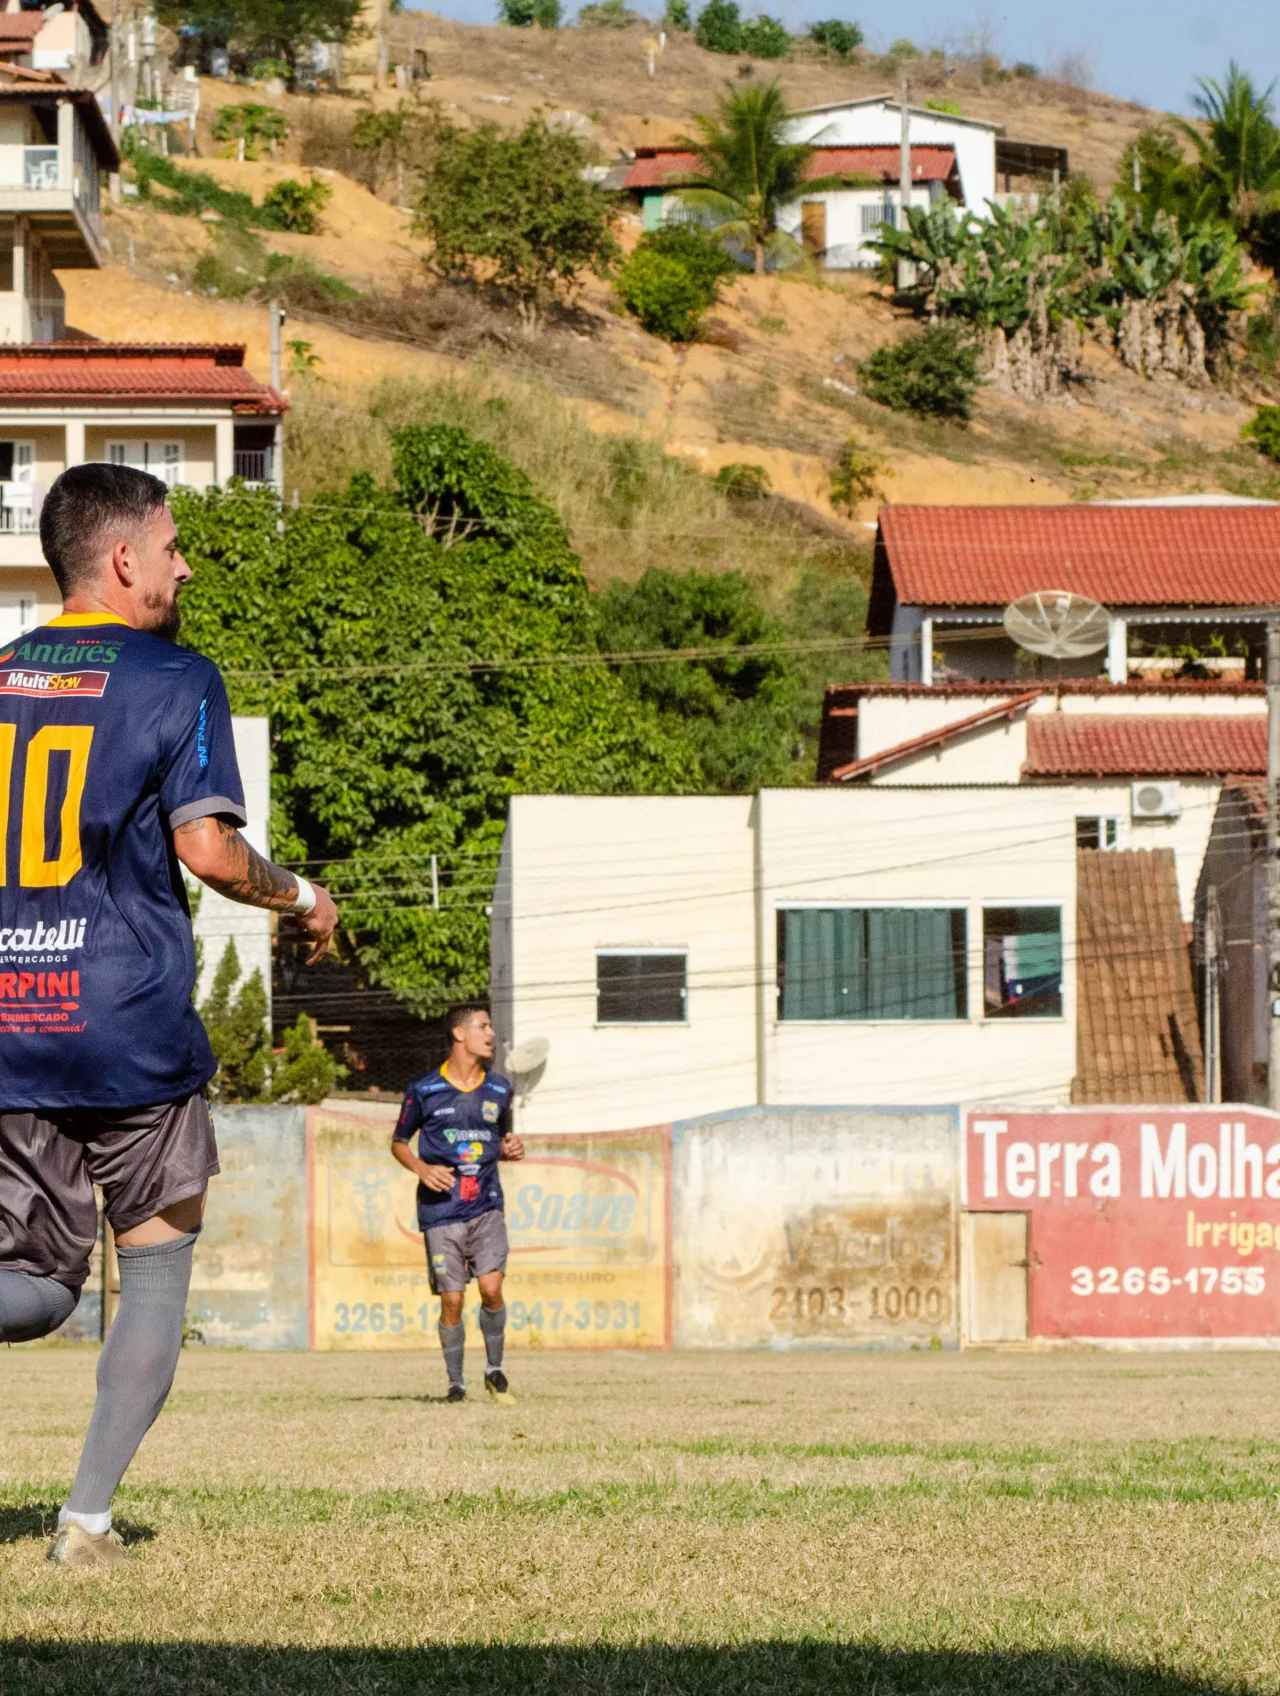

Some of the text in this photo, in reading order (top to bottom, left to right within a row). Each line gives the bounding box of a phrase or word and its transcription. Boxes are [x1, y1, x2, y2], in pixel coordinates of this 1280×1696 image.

[12, 641, 121, 664] Antares
[6, 672, 81, 690] MultiShow
[973, 1120, 1121, 1198] Terra
[508, 1184, 637, 1234] Soave
[374, 1273, 431, 1287] RAPID
[1070, 1265, 1266, 1296] 3265-1755
[334, 1300, 641, 1333] 3265-121 947-3931
